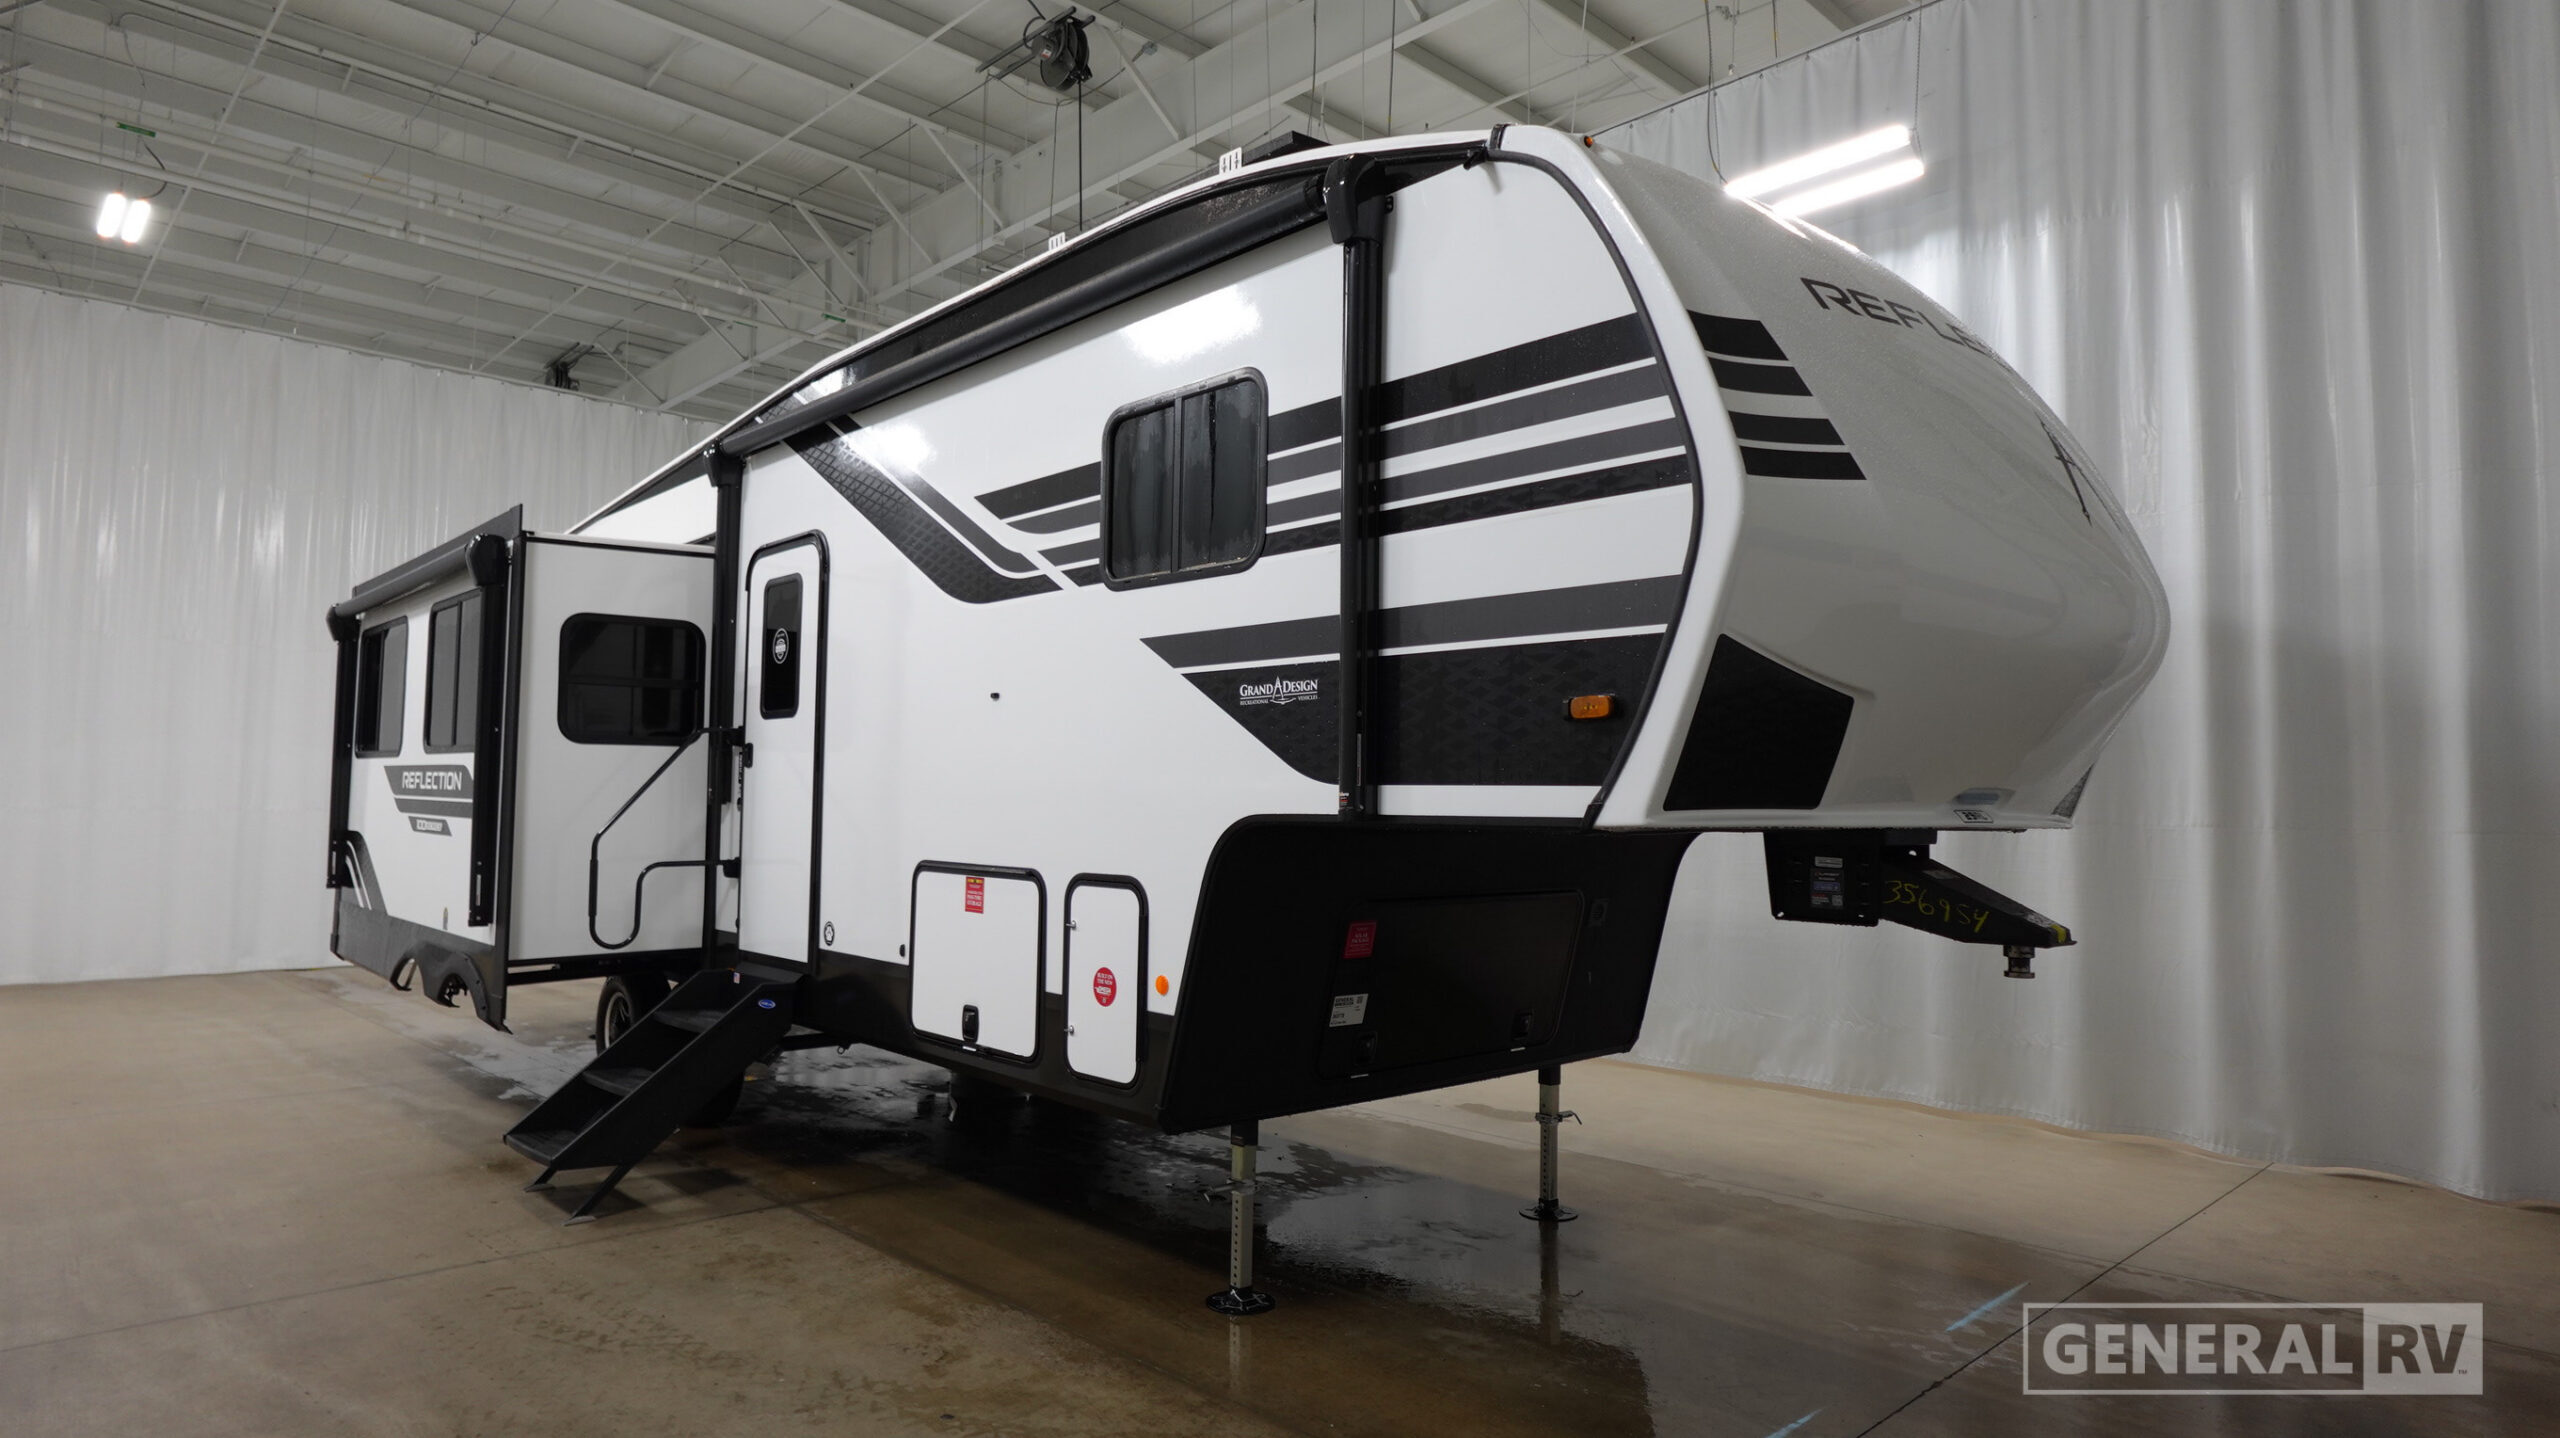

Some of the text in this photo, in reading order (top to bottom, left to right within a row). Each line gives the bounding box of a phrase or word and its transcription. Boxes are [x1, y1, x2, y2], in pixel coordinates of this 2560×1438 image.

[1800, 277, 2003, 365] REFLE
[1240, 679, 1319, 697] GRAND DESIGN
[402, 771, 462, 791] REFLECTION
